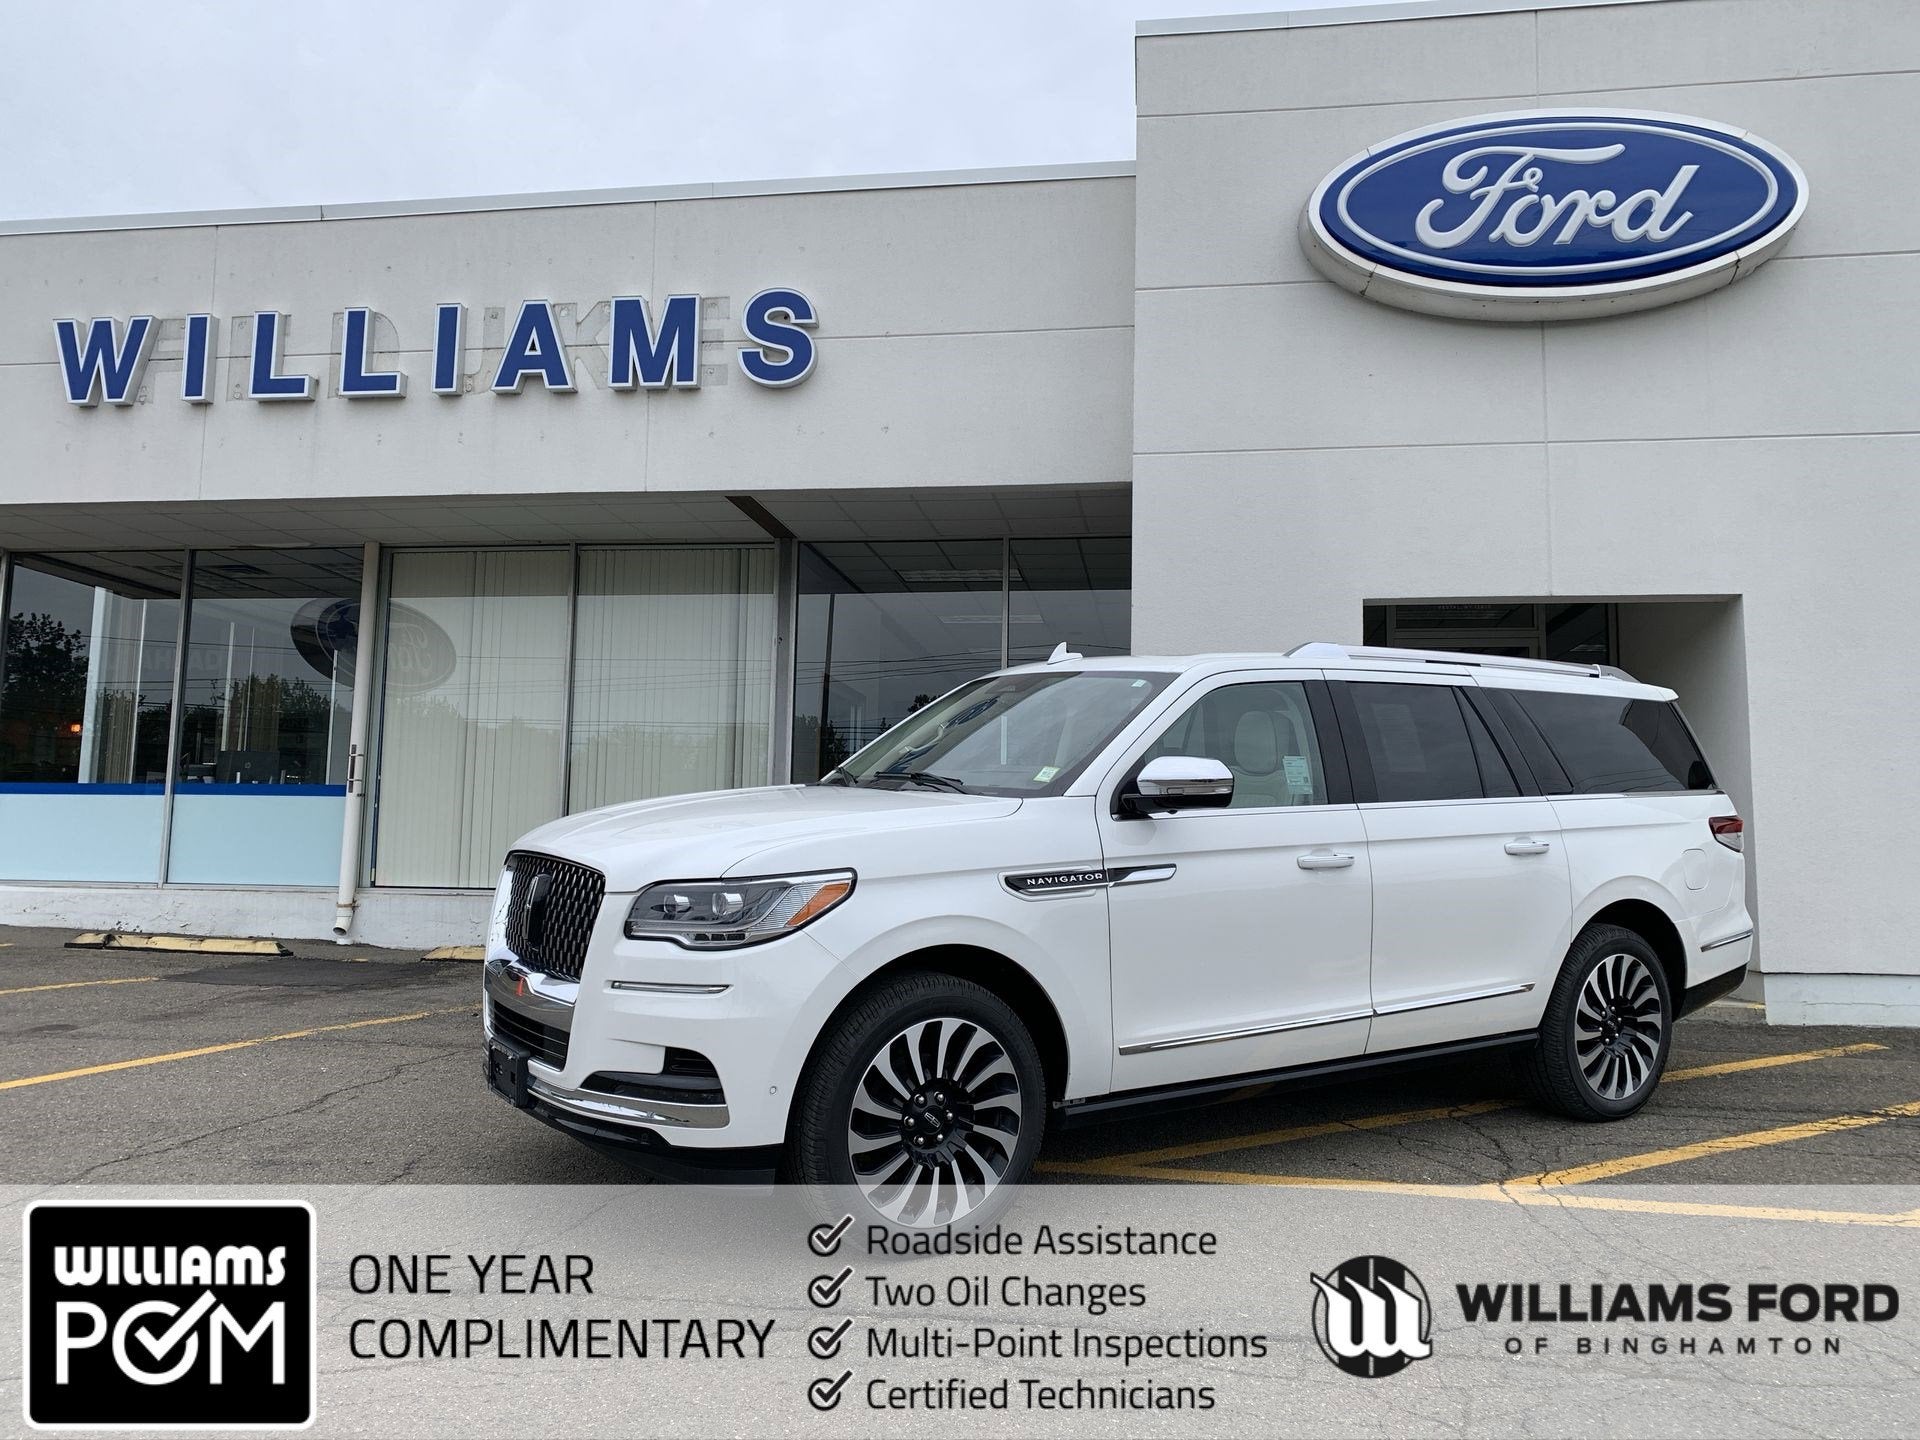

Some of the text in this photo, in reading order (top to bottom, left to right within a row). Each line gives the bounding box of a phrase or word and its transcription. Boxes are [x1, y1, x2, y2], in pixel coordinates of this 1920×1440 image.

[1415, 143, 1700, 249] Ford
[53, 286, 820, 408] WILLIAMS
[1026, 872, 1104, 886] NAVIGATOR
